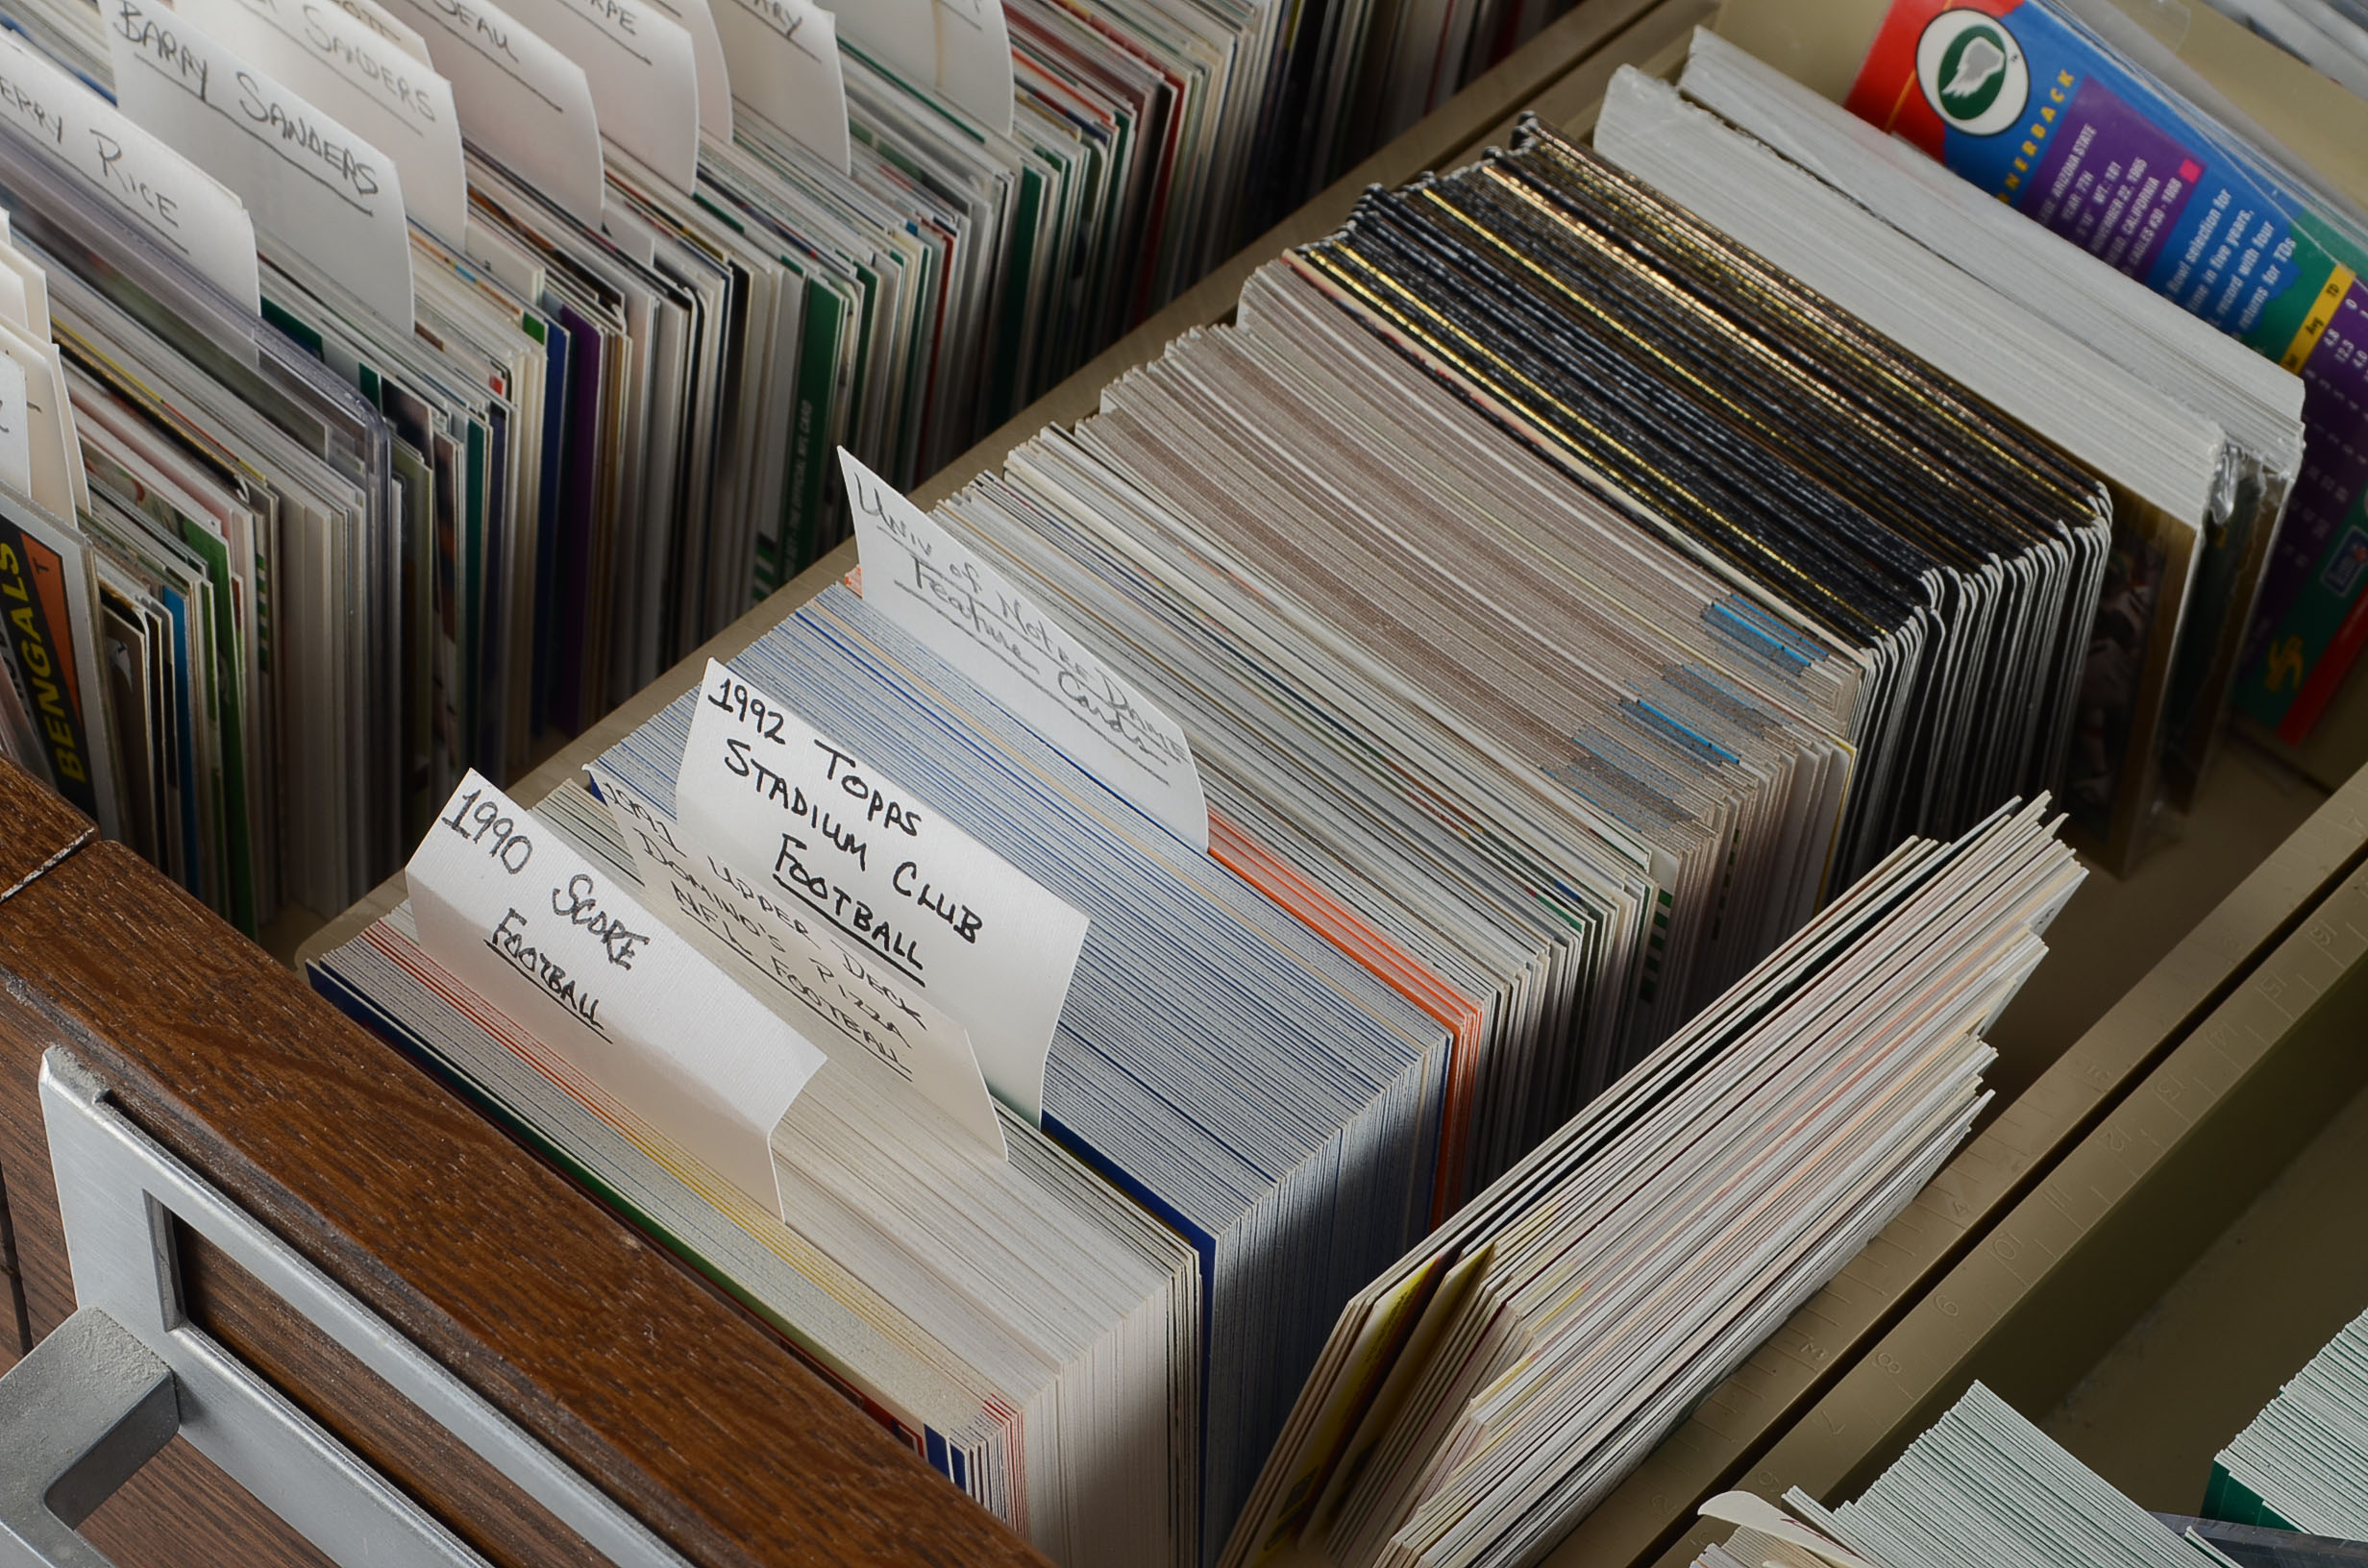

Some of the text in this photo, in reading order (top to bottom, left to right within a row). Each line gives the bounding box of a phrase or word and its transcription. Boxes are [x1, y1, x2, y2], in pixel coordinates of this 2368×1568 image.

[112, 0, 379, 195] BARRY SANDERS
[302, 4, 435, 122] SANDERS
[2051, 154, 2080, 198] ARIZONA
[2073, 123, 2097, 157] STATE
[2121, 176, 2160, 236] CALIFORNIA
[2185, 208, 2222, 264] selection
[2213, 188, 2232, 210] for
[2209, 244, 2232, 270] five
[2216, 273, 2244, 315] record
[2238, 247, 2260, 276] with
[2252, 220, 2275, 249] four
[2239, 236, 2297, 330] returns for TDs
[0, 541, 86, 784] BENGALS
[707, 677, 922, 839] 1992 TOPPS
[442, 789, 650, 971] 1990 SCORE
[724, 738, 984, 945] STADIUM CLUB
[774, 834, 925, 969] FOOTBALL
[491, 907, 607, 1030] FOOTBALL
[640, 826, 912, 1049] DOMINO'S PIZZA
[672, 883, 913, 1066] NFL FOOTBALL
[707, 855, 813, 938] UPPER
[843, 943, 927, 1031] DECK
